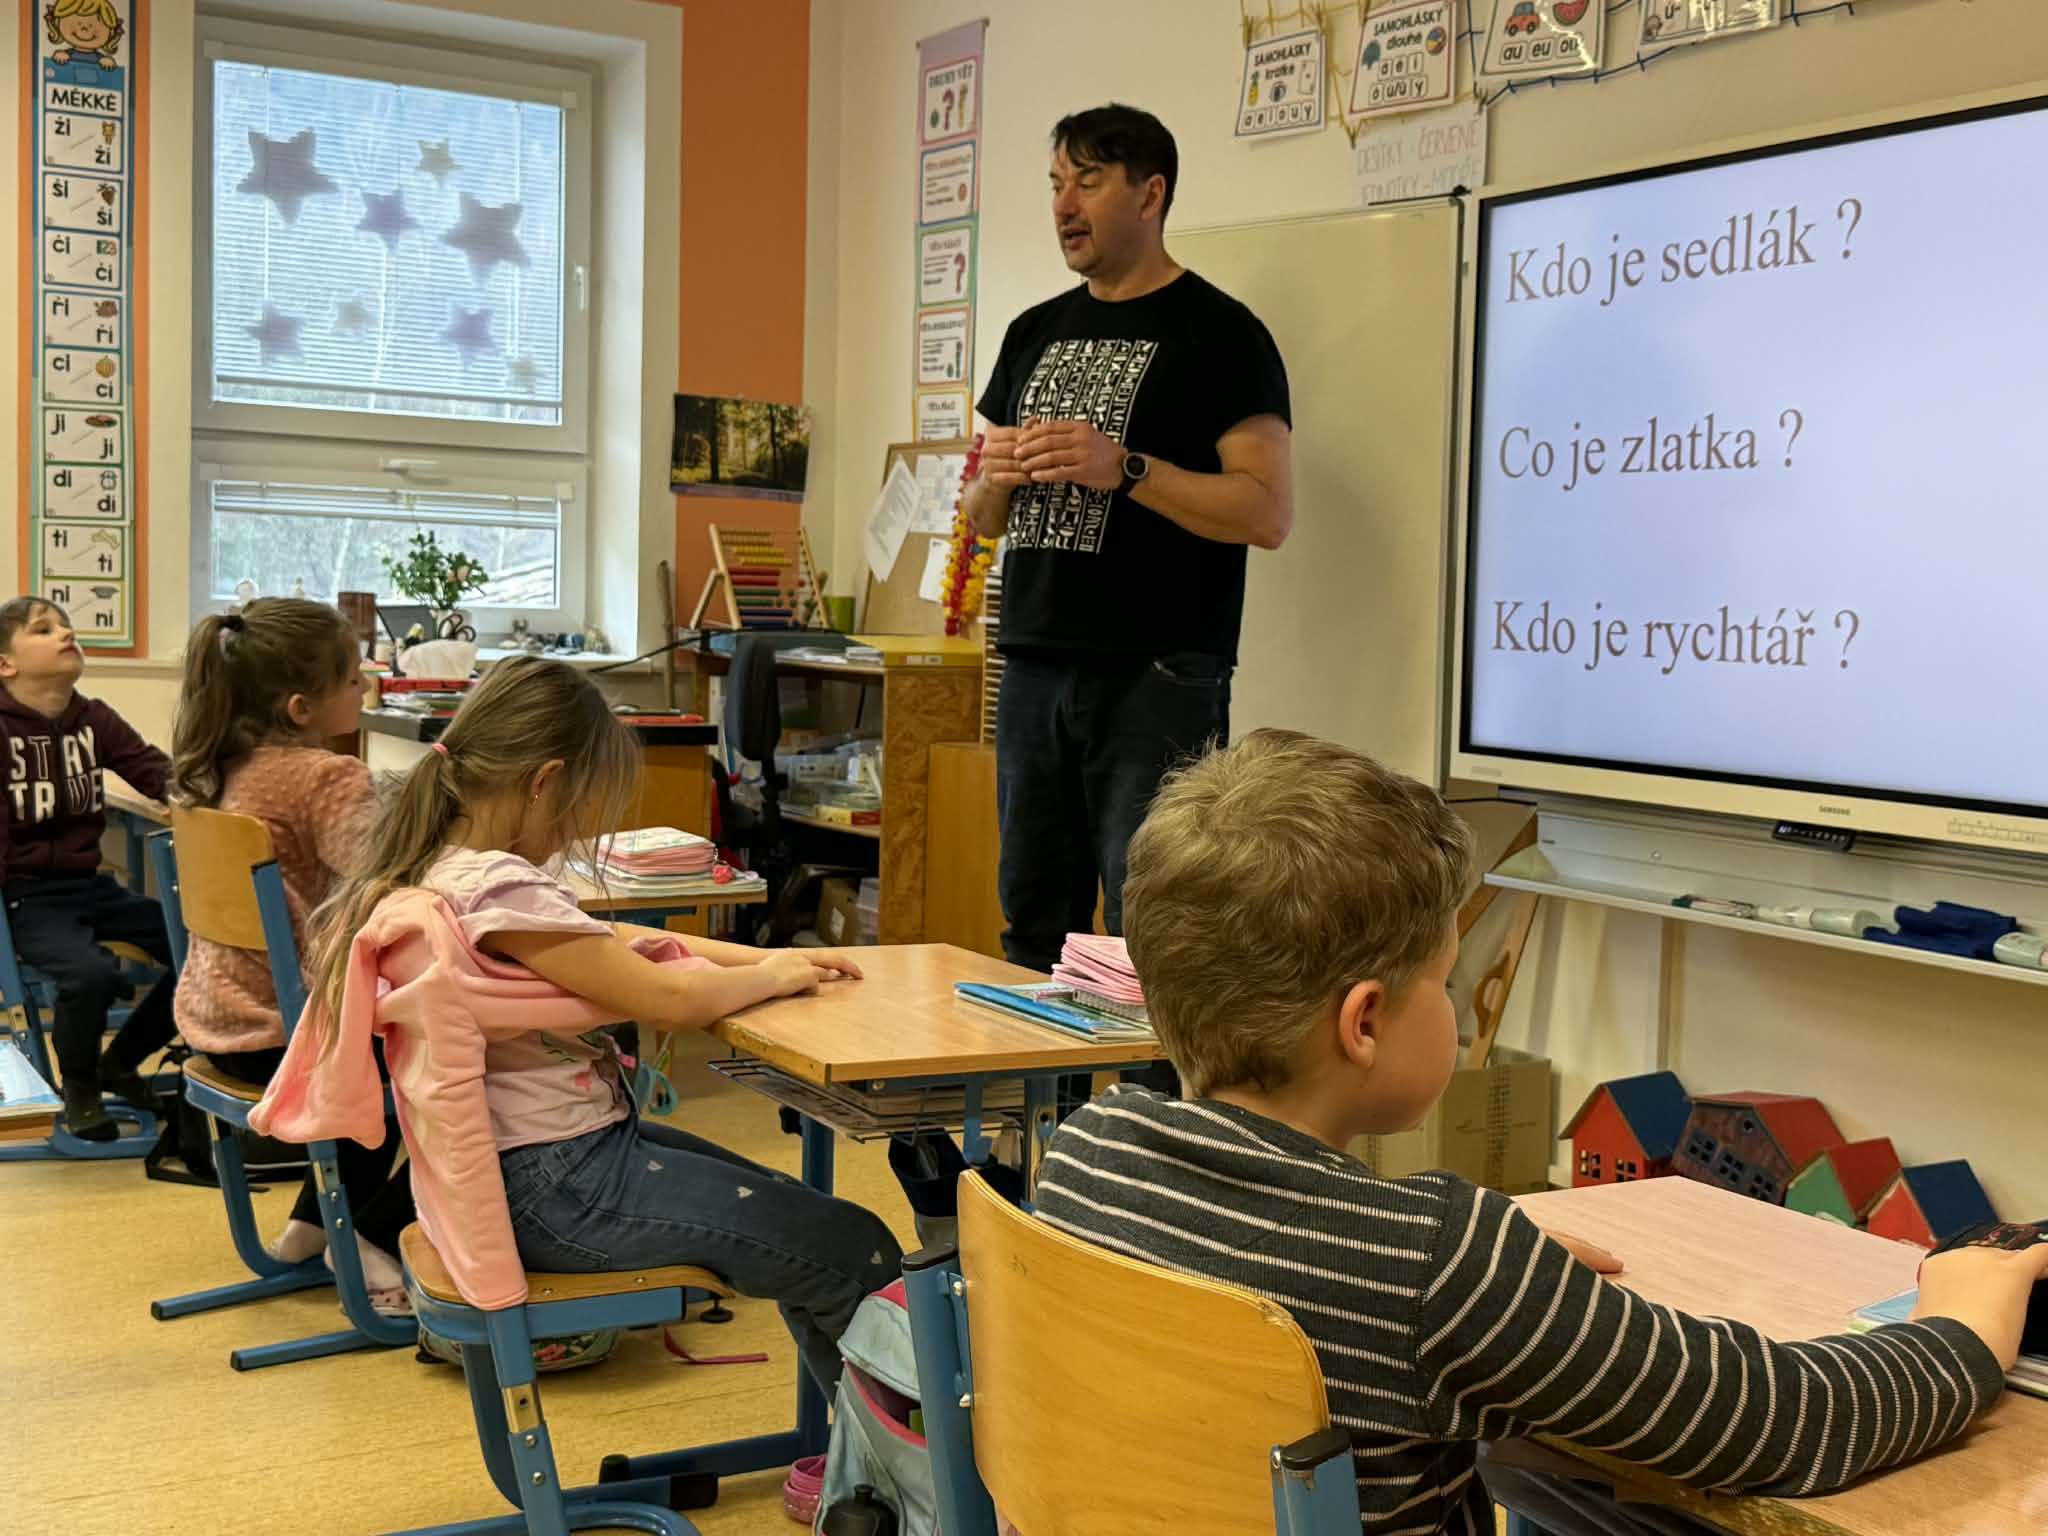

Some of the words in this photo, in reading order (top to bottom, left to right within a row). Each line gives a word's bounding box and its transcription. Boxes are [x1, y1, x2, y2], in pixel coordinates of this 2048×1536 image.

[1373, 8, 1443, 37] SAMOHLÁSKY
[1254, 42, 1312, 67] SAMOHLÁSKY
[1503, 45, 1522, 60] au
[1532, 42, 1551, 57] eu
[1560, 38, 1578, 53] ou
[51, 87, 117, 112] MĚKKÉ
[1506, 243, 1591, 303] Kdo
[1600, 234, 1645, 306] je
[1661, 206, 1816, 282] sedlák
[1837, 199, 1863, 259] ?
[52, 354, 70, 372] ci
[51, 414, 65, 435] ji
[1500, 427, 1554, 478] Co
[1563, 422, 1605, 491] je
[1620, 413, 1759, 473] zlatka
[1779, 409, 1803, 467] ?
[53, 469, 72, 488] di
[53, 529, 68, 548] ti
[52, 585, 70, 603] ni
[1493, 600, 1576, 654] Kdo
[1584, 602, 1629, 671] je
[1642, 606, 1815, 675] rychtář
[1834, 610, 1860, 669] ?
[9, 725, 97, 780] STAY
